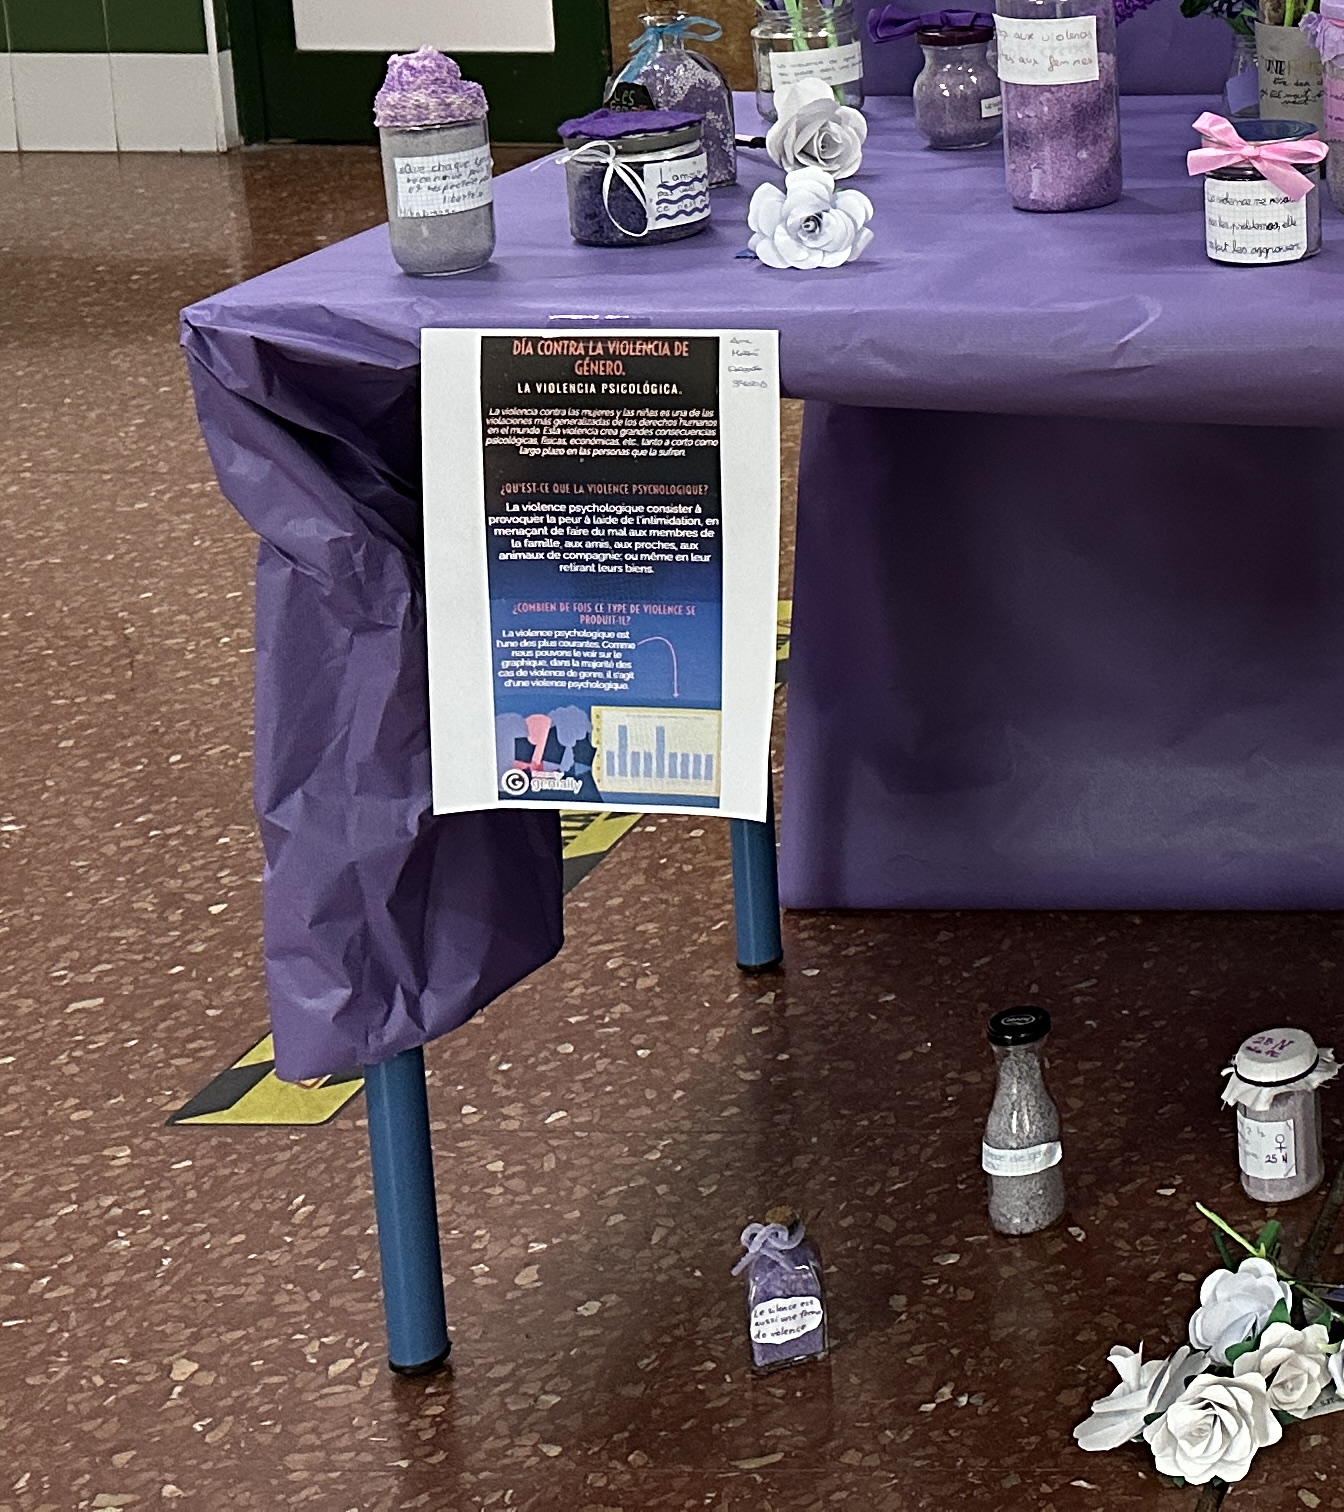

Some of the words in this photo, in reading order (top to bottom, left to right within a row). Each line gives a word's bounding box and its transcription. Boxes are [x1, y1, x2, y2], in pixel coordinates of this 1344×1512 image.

[513, 338, 533, 355] DÍA
[537, 340, 585, 356] CONTRA
[589, 341, 604, 356] LA
[608, 341, 671, 356] VIOLENCIA
[674, 341, 689, 356] DE
[575, 357, 626, 376] GÉNERO.
[518, 383, 531, 394] LA
[536, 382, 596, 394] VIOLENCIA
[601, 380, 683, 395] PSICOLÓGICA.
[553, 483, 571, 495] QUE
[574, 484, 585, 495] LA
[588, 484, 629, 495] VIOLENCE
[506, 502, 520, 512] La
[522, 502, 566, 513] violence
[568, 503, 645, 515] psychologique
[560, 603, 570, 612] DE
[573, 603, 591, 613] FOIS
[607, 603, 627, 614] TYPE
[630, 604, 640, 614] DE
[643, 604, 683, 615] VIOLENCE
